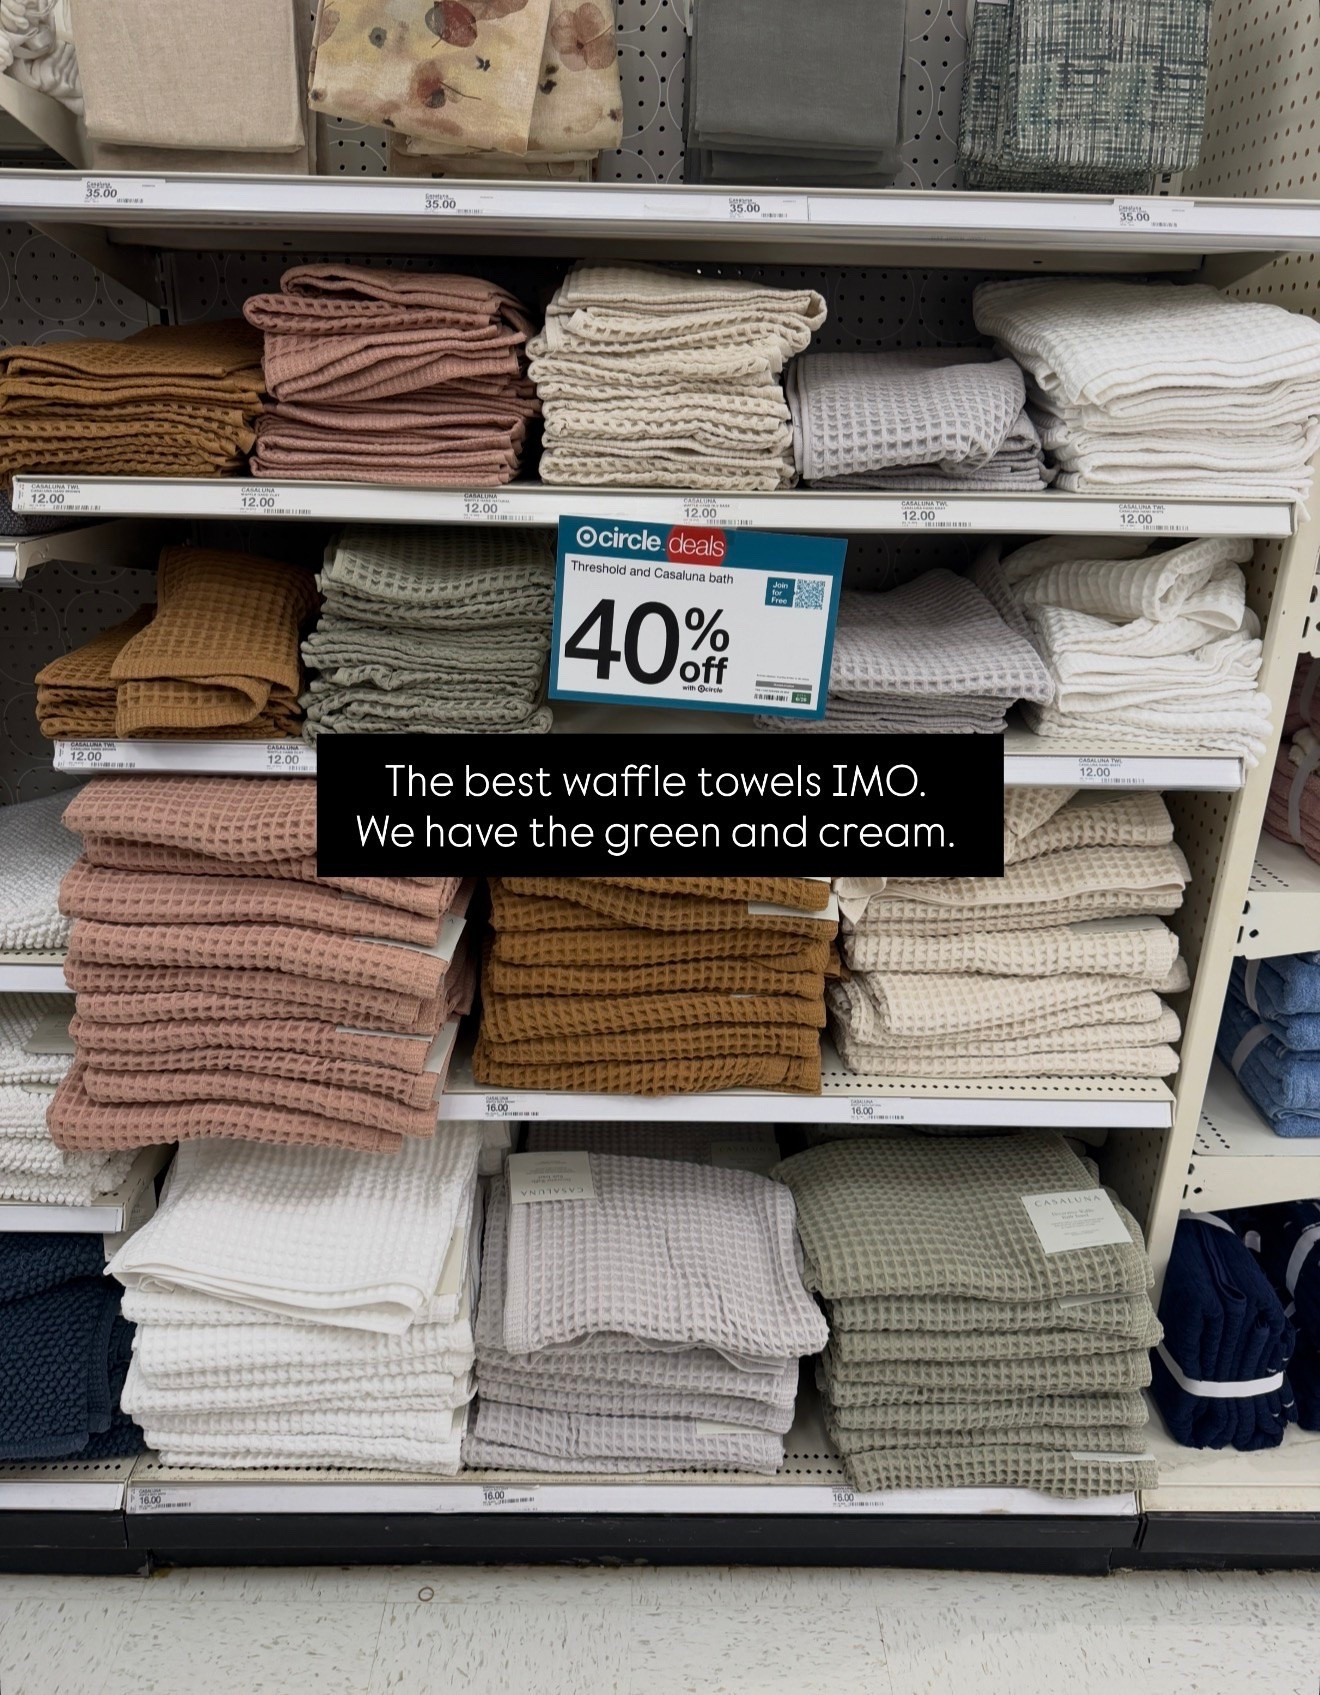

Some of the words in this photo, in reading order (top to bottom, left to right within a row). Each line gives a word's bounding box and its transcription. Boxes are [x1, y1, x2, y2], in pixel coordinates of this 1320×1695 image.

[86, 188, 118, 198] 35.00
[425, 199, 457, 209] 35.00
[729, 204, 760, 213] 35.00
[1119, 212, 1150, 222] 35.00
[31, 493, 65, 504] 12.00
[241, 497, 275, 508] 12.00
[464, 503, 498, 514] 12.00
[684, 508, 717, 518] 12.00
[902, 510, 936, 521] 12.00
[1120, 513, 1153, 524] 12.00
[598, 526, 662, 551] circle
[669, 532, 725, 558] deals
[571, 560, 627, 576] Threshold
[629, 567, 651, 577] and
[654, 567, 706, 583] Casaluna
[708, 572, 734, 585] bath
[772, 581, 789, 589] Join
[771, 596, 788, 605] Free
[679, 656, 728, 685] off
[70, 751, 102, 761] 12.00
[268, 754, 299, 765] 12.00
[1080, 767, 1111, 777] 12.00
[486, 1103, 509, 1112] 16.00
[851, 1106, 874, 1115] 16.00
[1034, 1194, 1101, 1208] CASALUNA
[140, 1495, 162, 1505] 16.00
[483, 1490, 505, 1500] 16.00
[833, 1493, 855, 1502] 16.00
